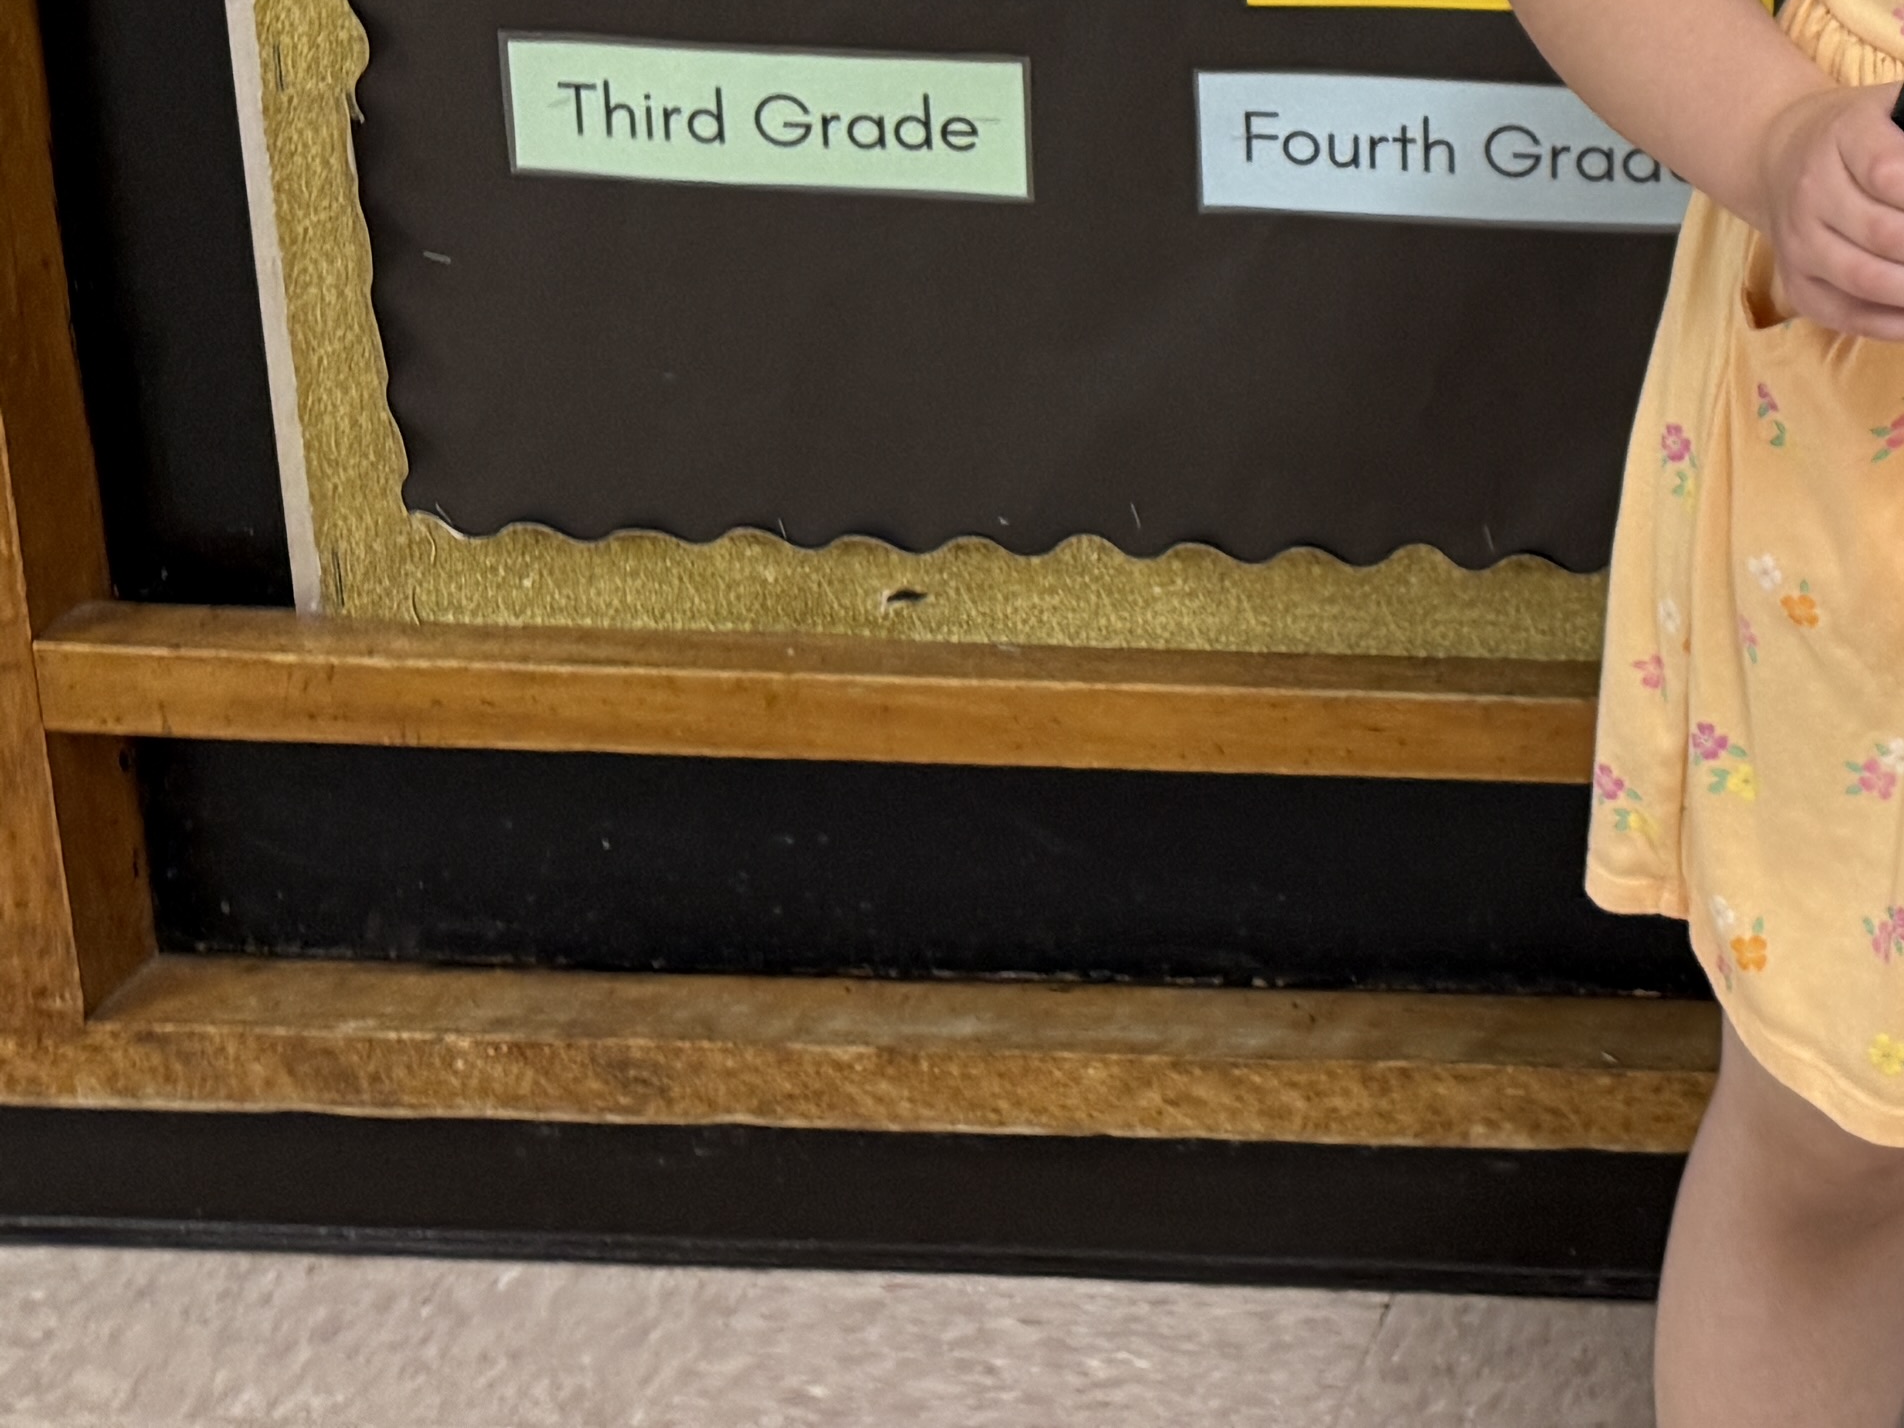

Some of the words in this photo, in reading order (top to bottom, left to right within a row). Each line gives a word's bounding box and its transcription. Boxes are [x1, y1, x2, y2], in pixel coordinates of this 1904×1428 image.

[557, 79, 726, 144] Third
[754, 93, 978, 151] Grade
[1244, 111, 1456, 175] Fourth
[1485, 124, 1690, 183] Grad
